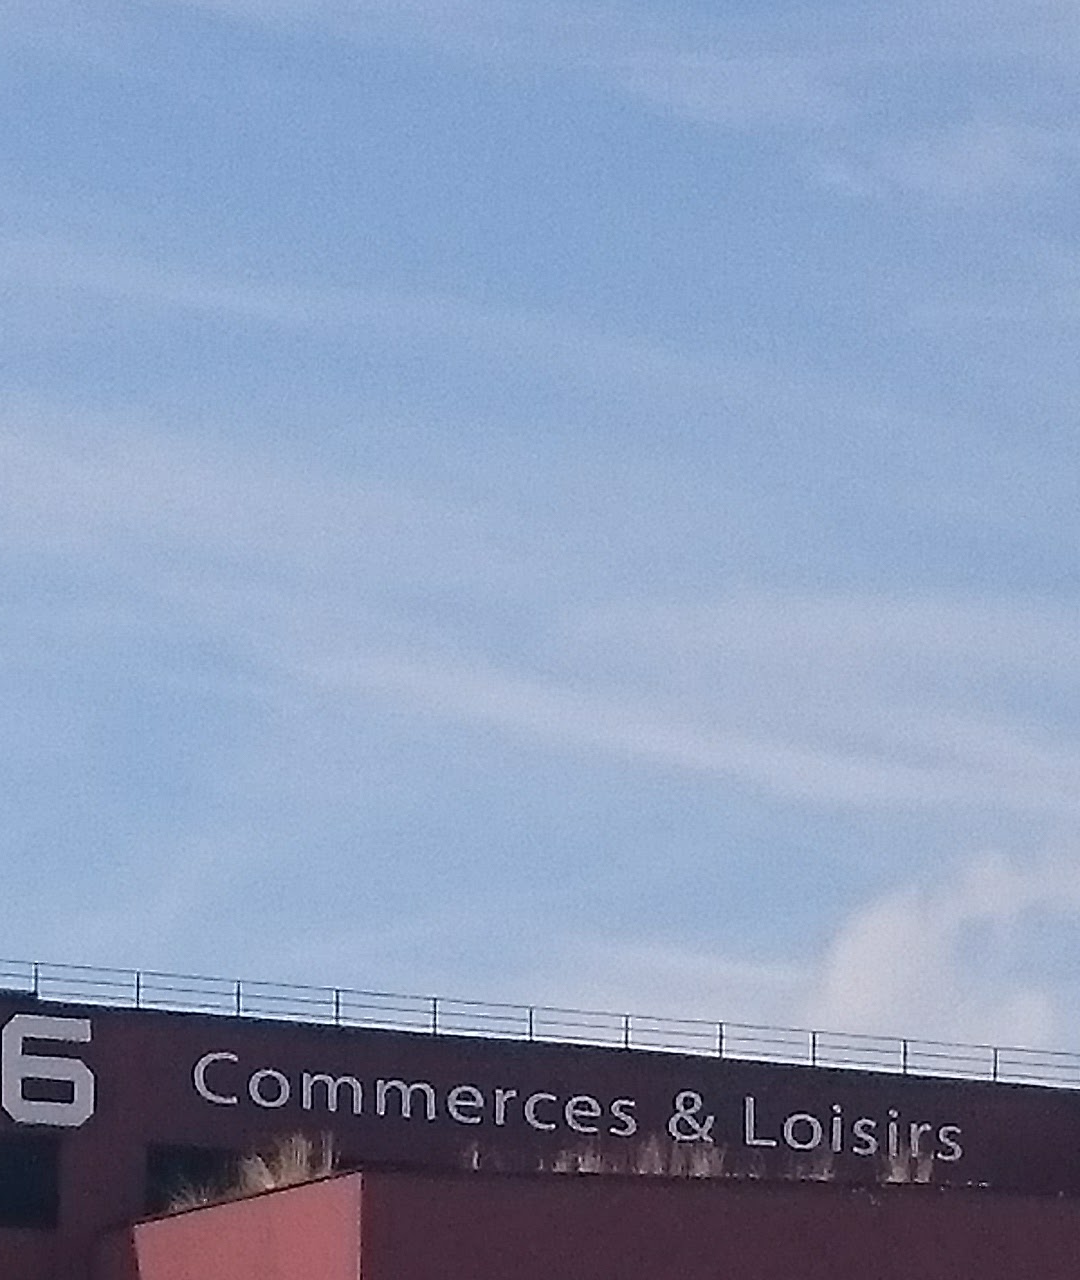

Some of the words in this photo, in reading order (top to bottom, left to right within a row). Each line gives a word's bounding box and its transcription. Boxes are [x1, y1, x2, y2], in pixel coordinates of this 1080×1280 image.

[192, 1051, 637, 1136] Commerces
[668, 1090, 715, 1146] &
[745, 1096, 964, 1162] Loisirs
